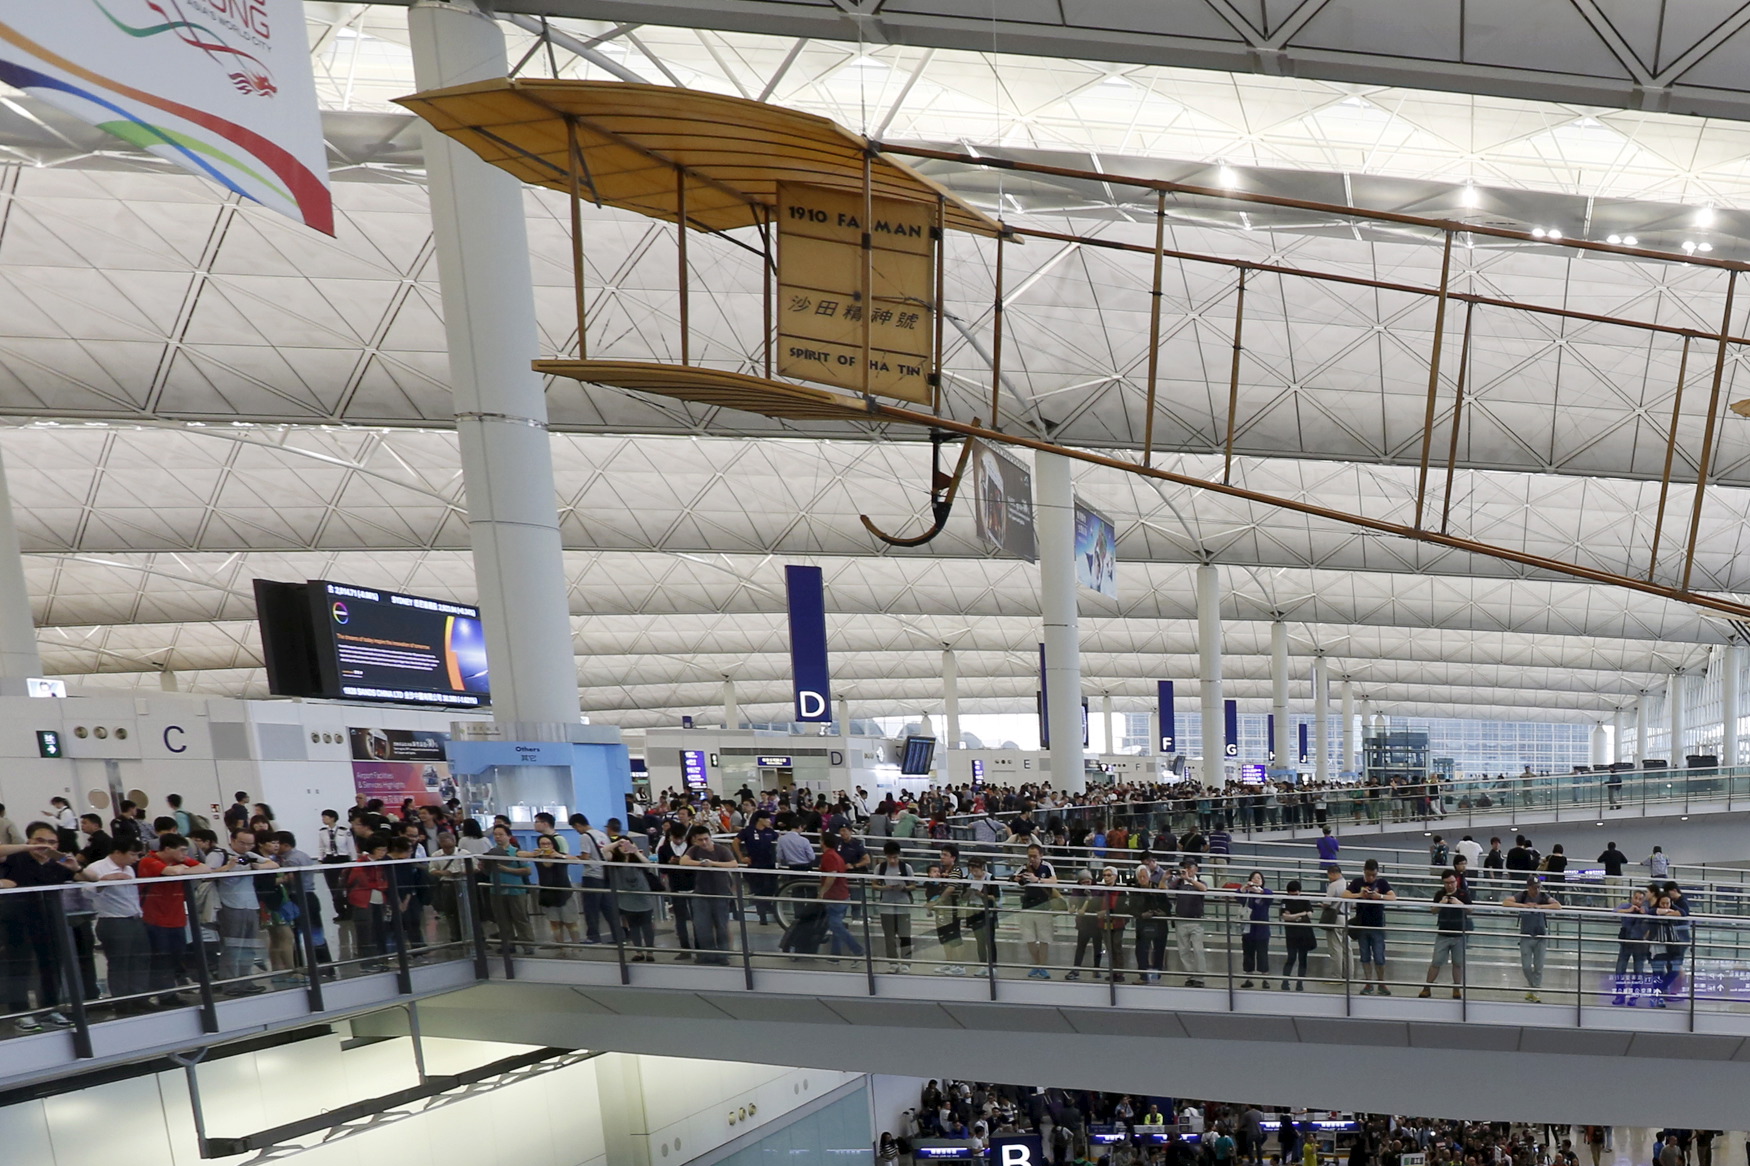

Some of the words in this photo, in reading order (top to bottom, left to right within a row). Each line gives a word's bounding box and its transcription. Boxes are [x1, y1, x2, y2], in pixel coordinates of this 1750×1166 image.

[218, 17, 251, 41] WORLD
[251, 36, 272, 52] CITY
[788, 205, 828, 224] 1910
[838, 213, 922, 238] FAMAN
[788, 295, 920, 330] 沙田精神號
[790, 347, 830, 363] SPIRIT
[838, 355, 856, 366] OF
[866, 360, 890, 373] HA
[897, 364, 921, 377] TIN
[799, 690, 826, 717] D
[163, 725, 187, 753] C
[1163, 737, 1172, 750] F
[1226, 743, 1238, 756] G
[831, 751, 843, 766] D
[1024, 759, 1030, 770] E
